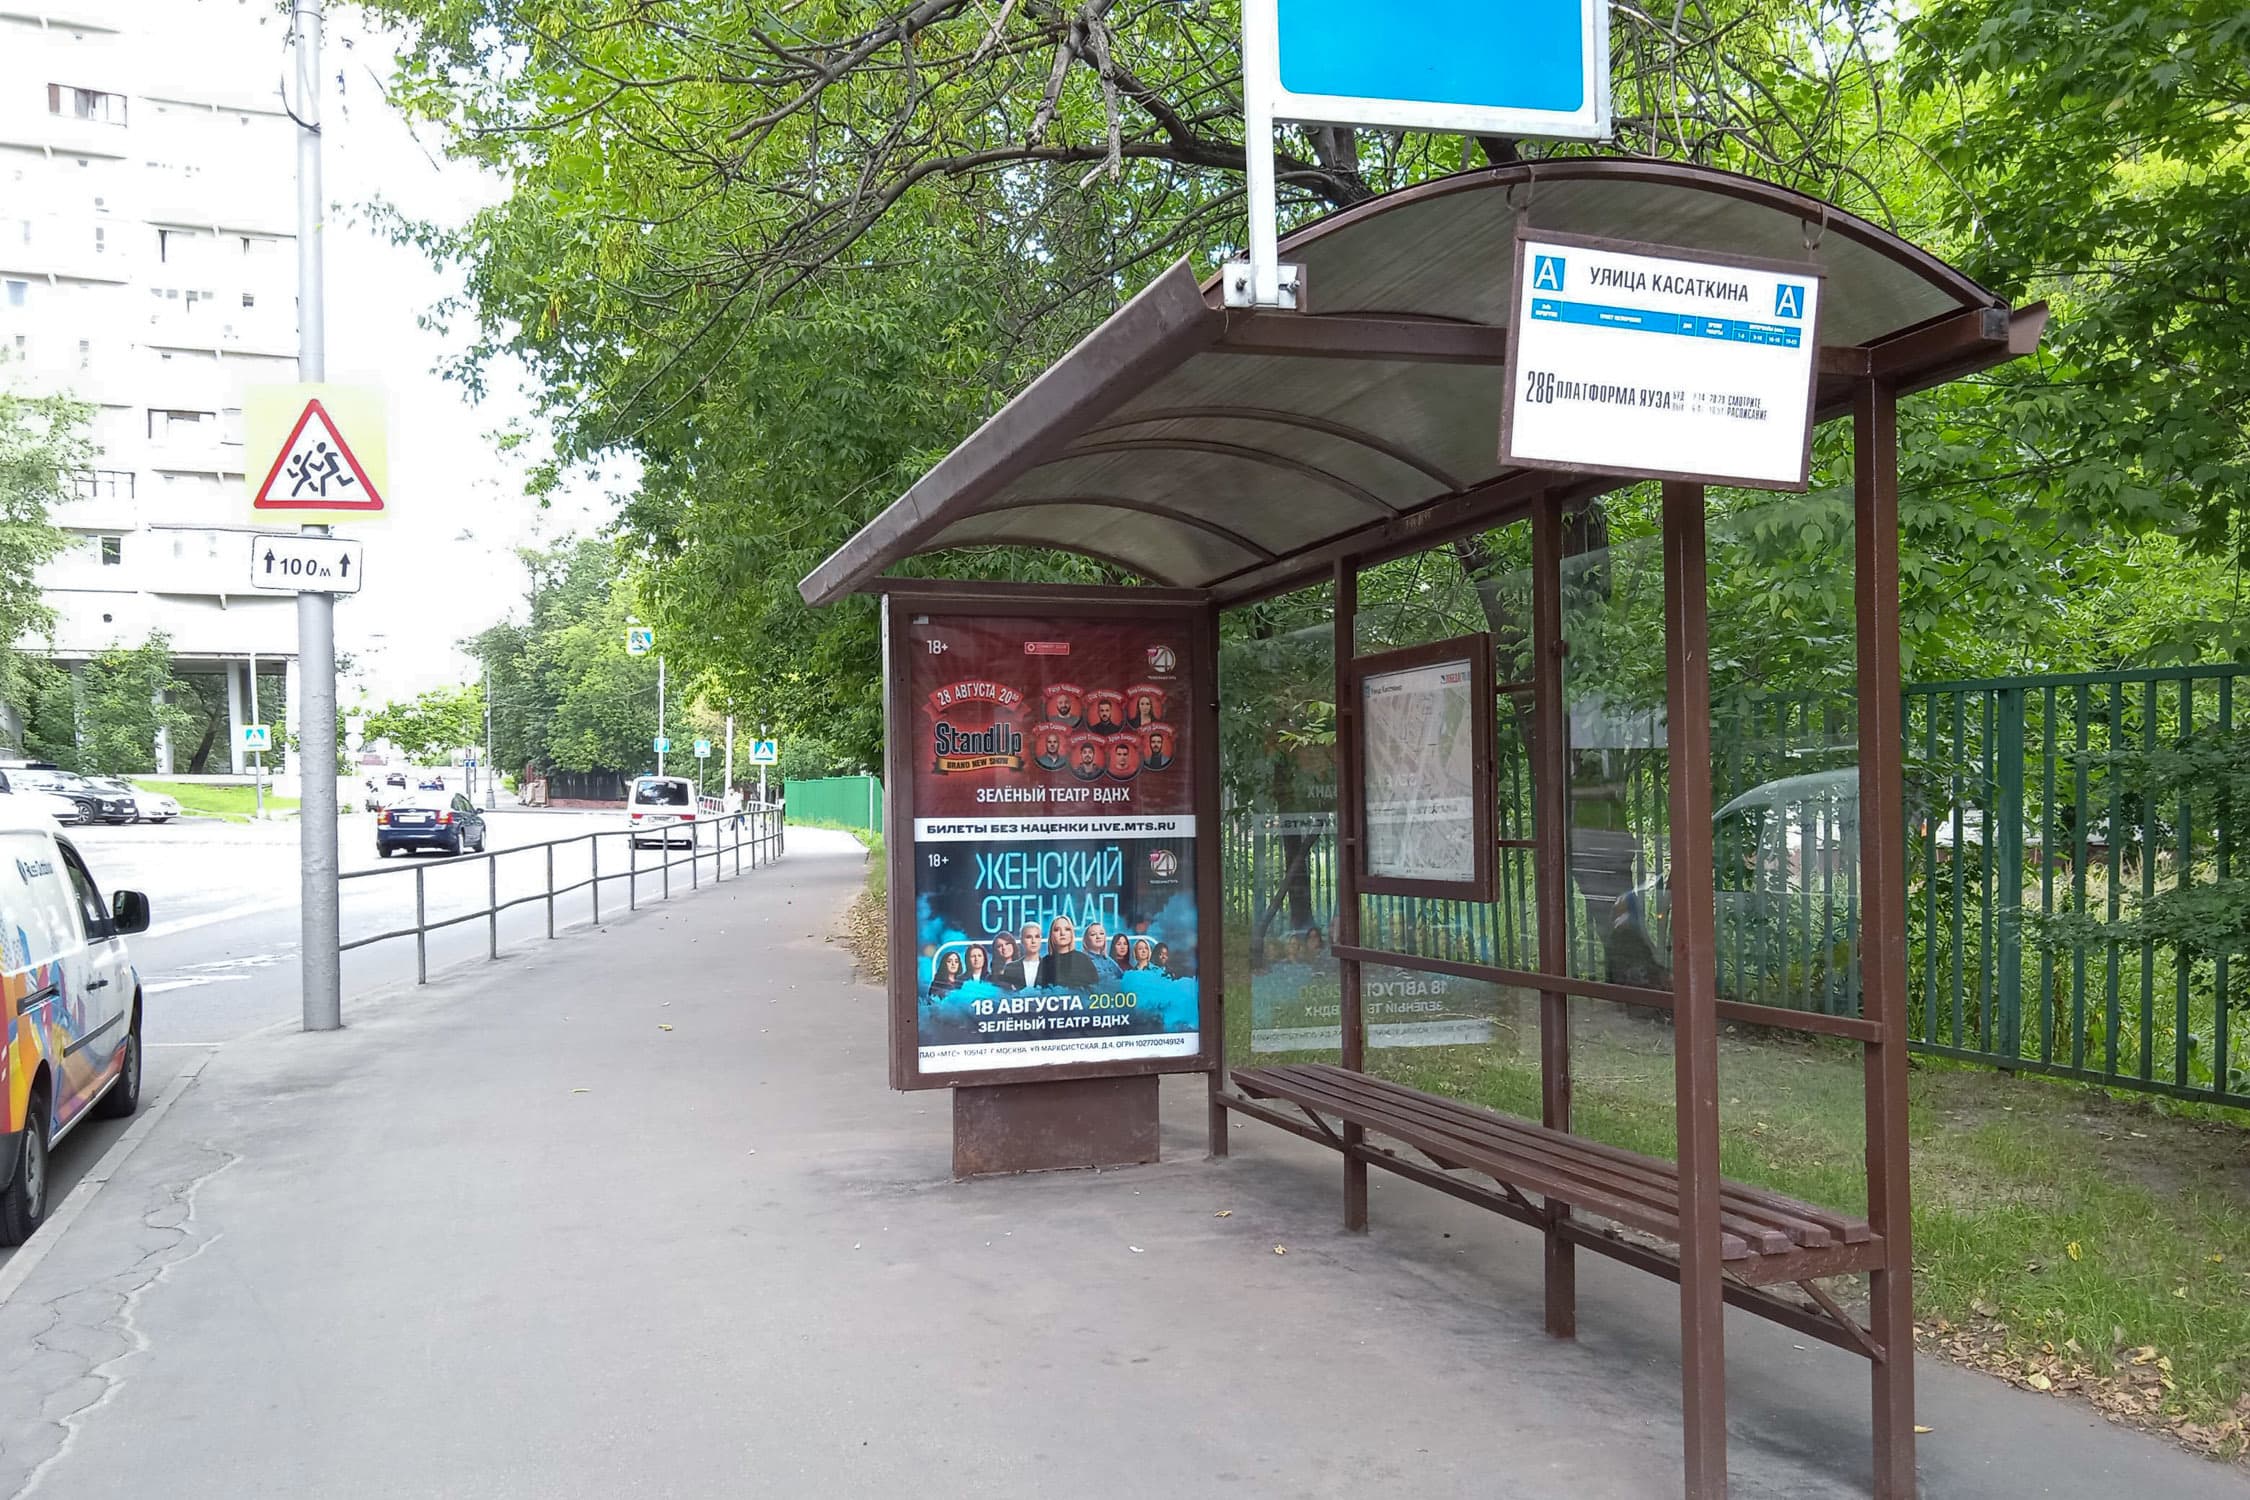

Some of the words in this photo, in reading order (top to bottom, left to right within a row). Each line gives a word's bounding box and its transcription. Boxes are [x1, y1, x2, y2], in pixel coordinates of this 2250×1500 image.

[1590, 266, 1646, 292] УЛИЦА
[1652, 273, 1749, 303] КАСАТКИНА
[1526, 370, 1555, 405] 286
[1557, 380, 1636, 407] ПЛАТФОРМА
[1640, 388, 1671, 410] ЯУЗА
[926, 640, 948, 655] 18+
[937, 690, 951, 706] 28
[954, 681, 996, 700] АВГУСТА
[946, 760, 970, 769] BRAND
[972, 757, 987, 768] NEW
[976, 784, 1045, 803] ЗЕЛЁНЫЙ
[1049, 788, 1090, 802] ТЕАТР
[1093, 788, 1130, 803] ВДНХ
[926, 824, 987, 835] БИЛЕТЫ
[990, 823, 1018, 834] БЕЗ
[1021, 823, 1089, 834] НАЦЕНКИ
[1091, 821, 1176, 832] LIVE.MTS.RU
[928, 853, 949, 868] 18+
[975, 846, 1123, 891] ЖЕНСКИЙ
[971, 999, 994, 1016] 18
[997, 995, 1083, 1015] АВГУСТА
[1088, 993, 1137, 1010] 20:00
[978, 1015, 1046, 1033] ЗЕЛЁНЫЙ
[1049, 1016, 1090, 1029] ТЕАТР
[1093, 1014, 1130, 1028] ВДНХ
[919, 1051, 936, 1060] ПАО
